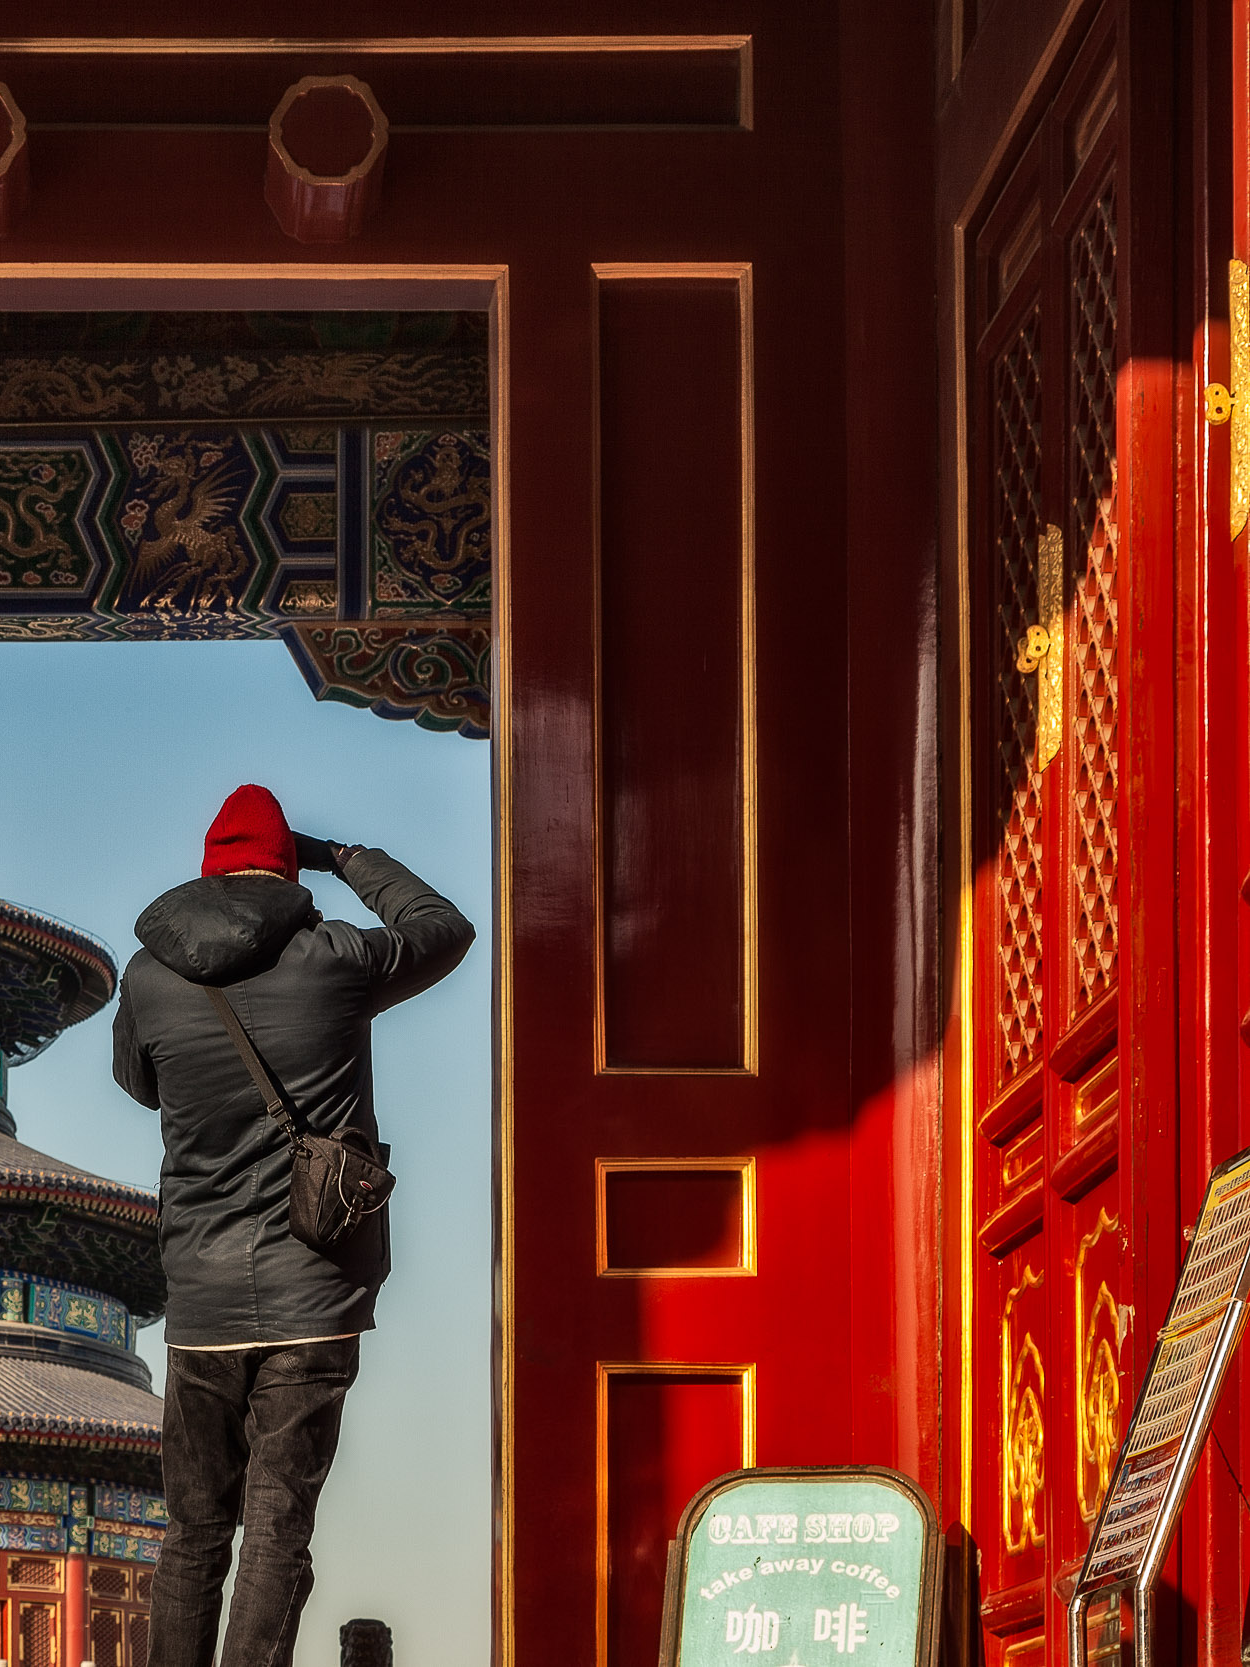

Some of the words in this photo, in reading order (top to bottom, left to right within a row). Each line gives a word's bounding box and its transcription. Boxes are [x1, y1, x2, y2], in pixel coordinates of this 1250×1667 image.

[708, 1514, 798, 1544] CAFE
[804, 1513, 899, 1543] SHOP
[700, 1565, 753, 1600] take
[760, 1557, 825, 1575] away
[831, 1559, 900, 1599] coffee
[725, 1602, 868, 1653] 咖啡
